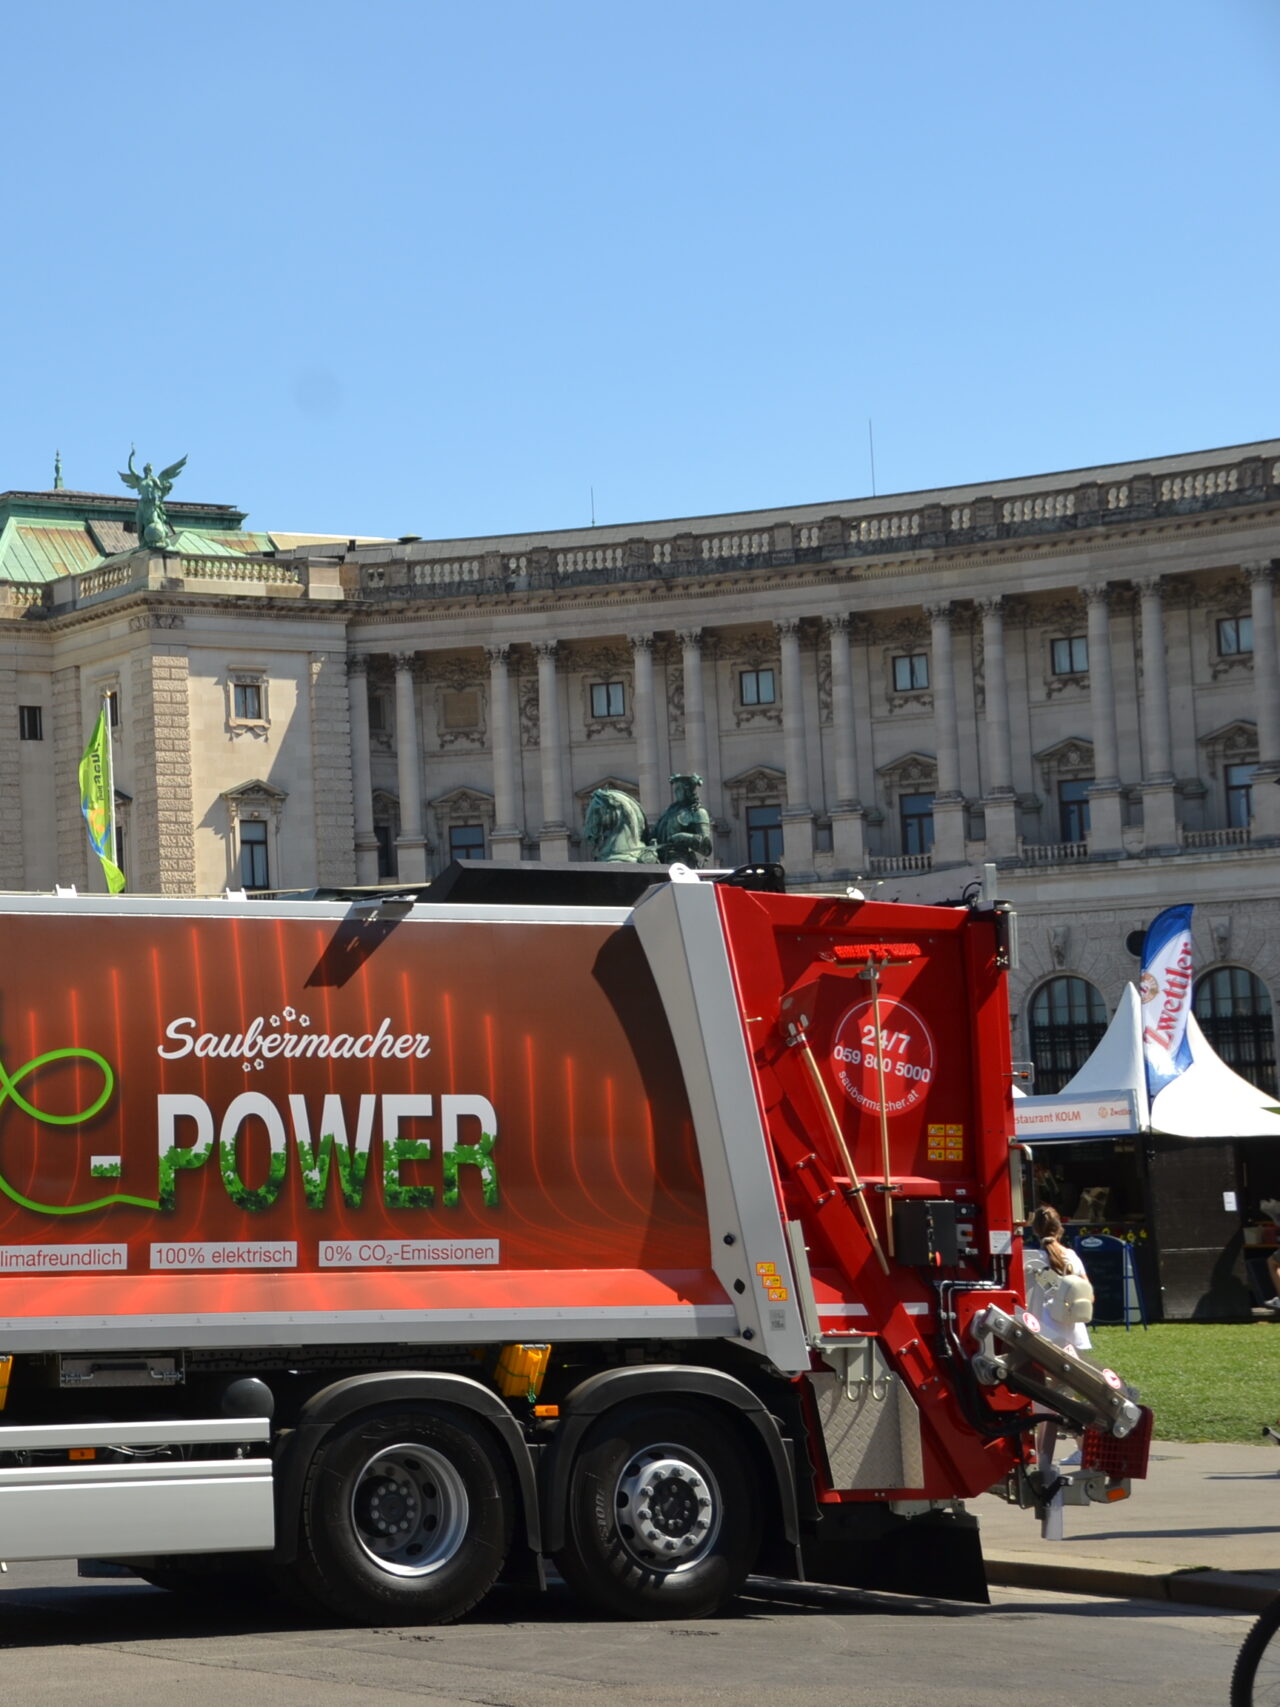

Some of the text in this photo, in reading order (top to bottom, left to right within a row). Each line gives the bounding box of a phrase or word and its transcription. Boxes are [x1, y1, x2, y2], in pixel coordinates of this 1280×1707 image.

[1143, 942, 1193, 1052] Zwettler
[157, 1016, 430, 1059] Saubermacher
[861, 1025, 911, 1054] 24/7
[833, 1045, 861, 1064] 059
[895, 1061, 931, 1083] 5000
[838, 1070, 920, 1112] saubermacher.at
[1055, 1110, 1082, 1122] KOLM
[155, 1246, 293, 1264] 100% elektrisch
[324, 1245, 352, 1262] 0%
